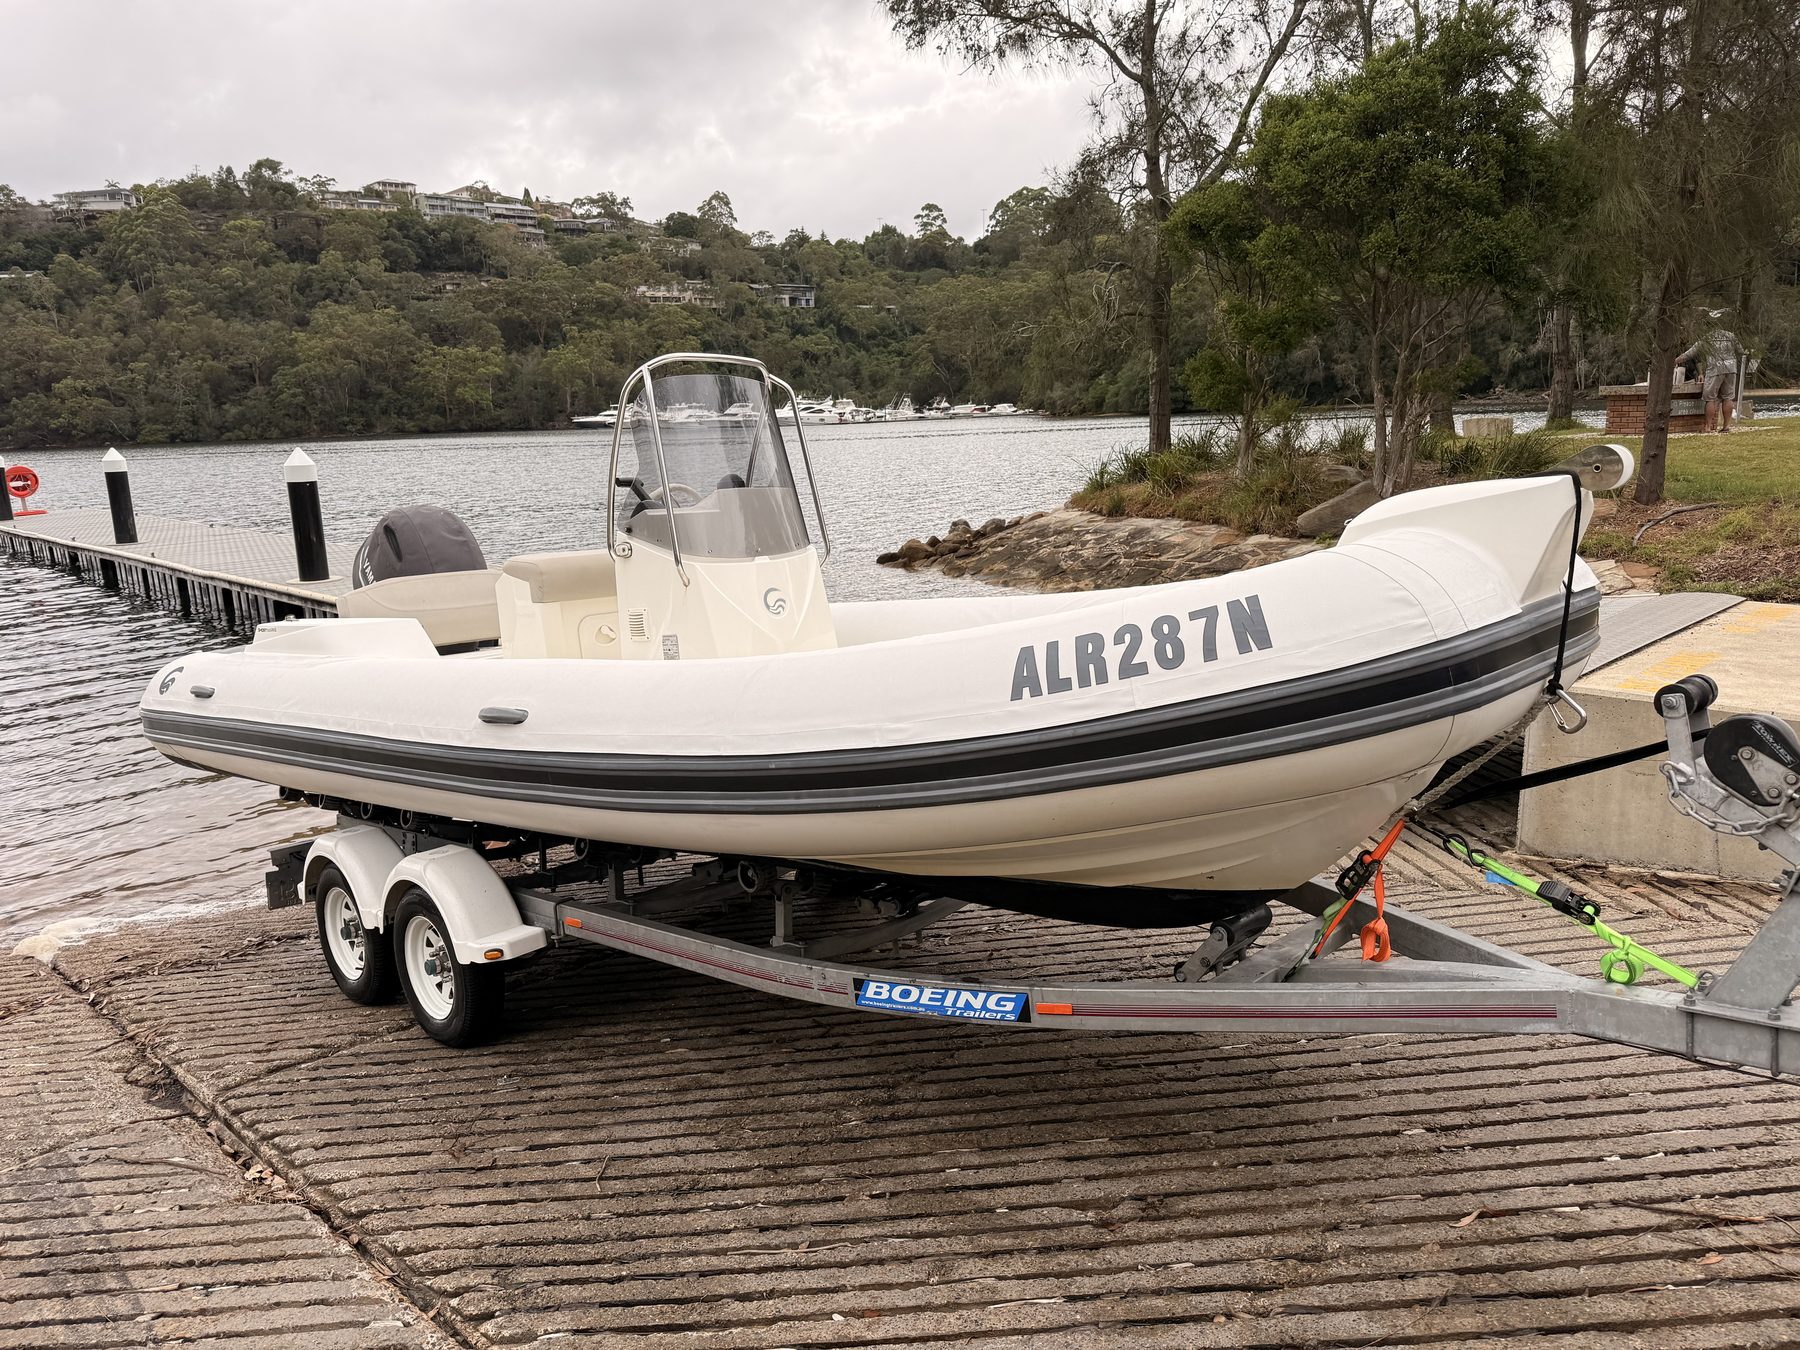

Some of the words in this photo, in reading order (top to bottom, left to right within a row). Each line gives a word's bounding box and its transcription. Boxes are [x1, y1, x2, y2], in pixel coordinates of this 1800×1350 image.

[1010, 594, 1273, 701] ALR287N
[865, 981, 1017, 1011] BOEING
[945, 1007, 1016, 1021] Trailers
